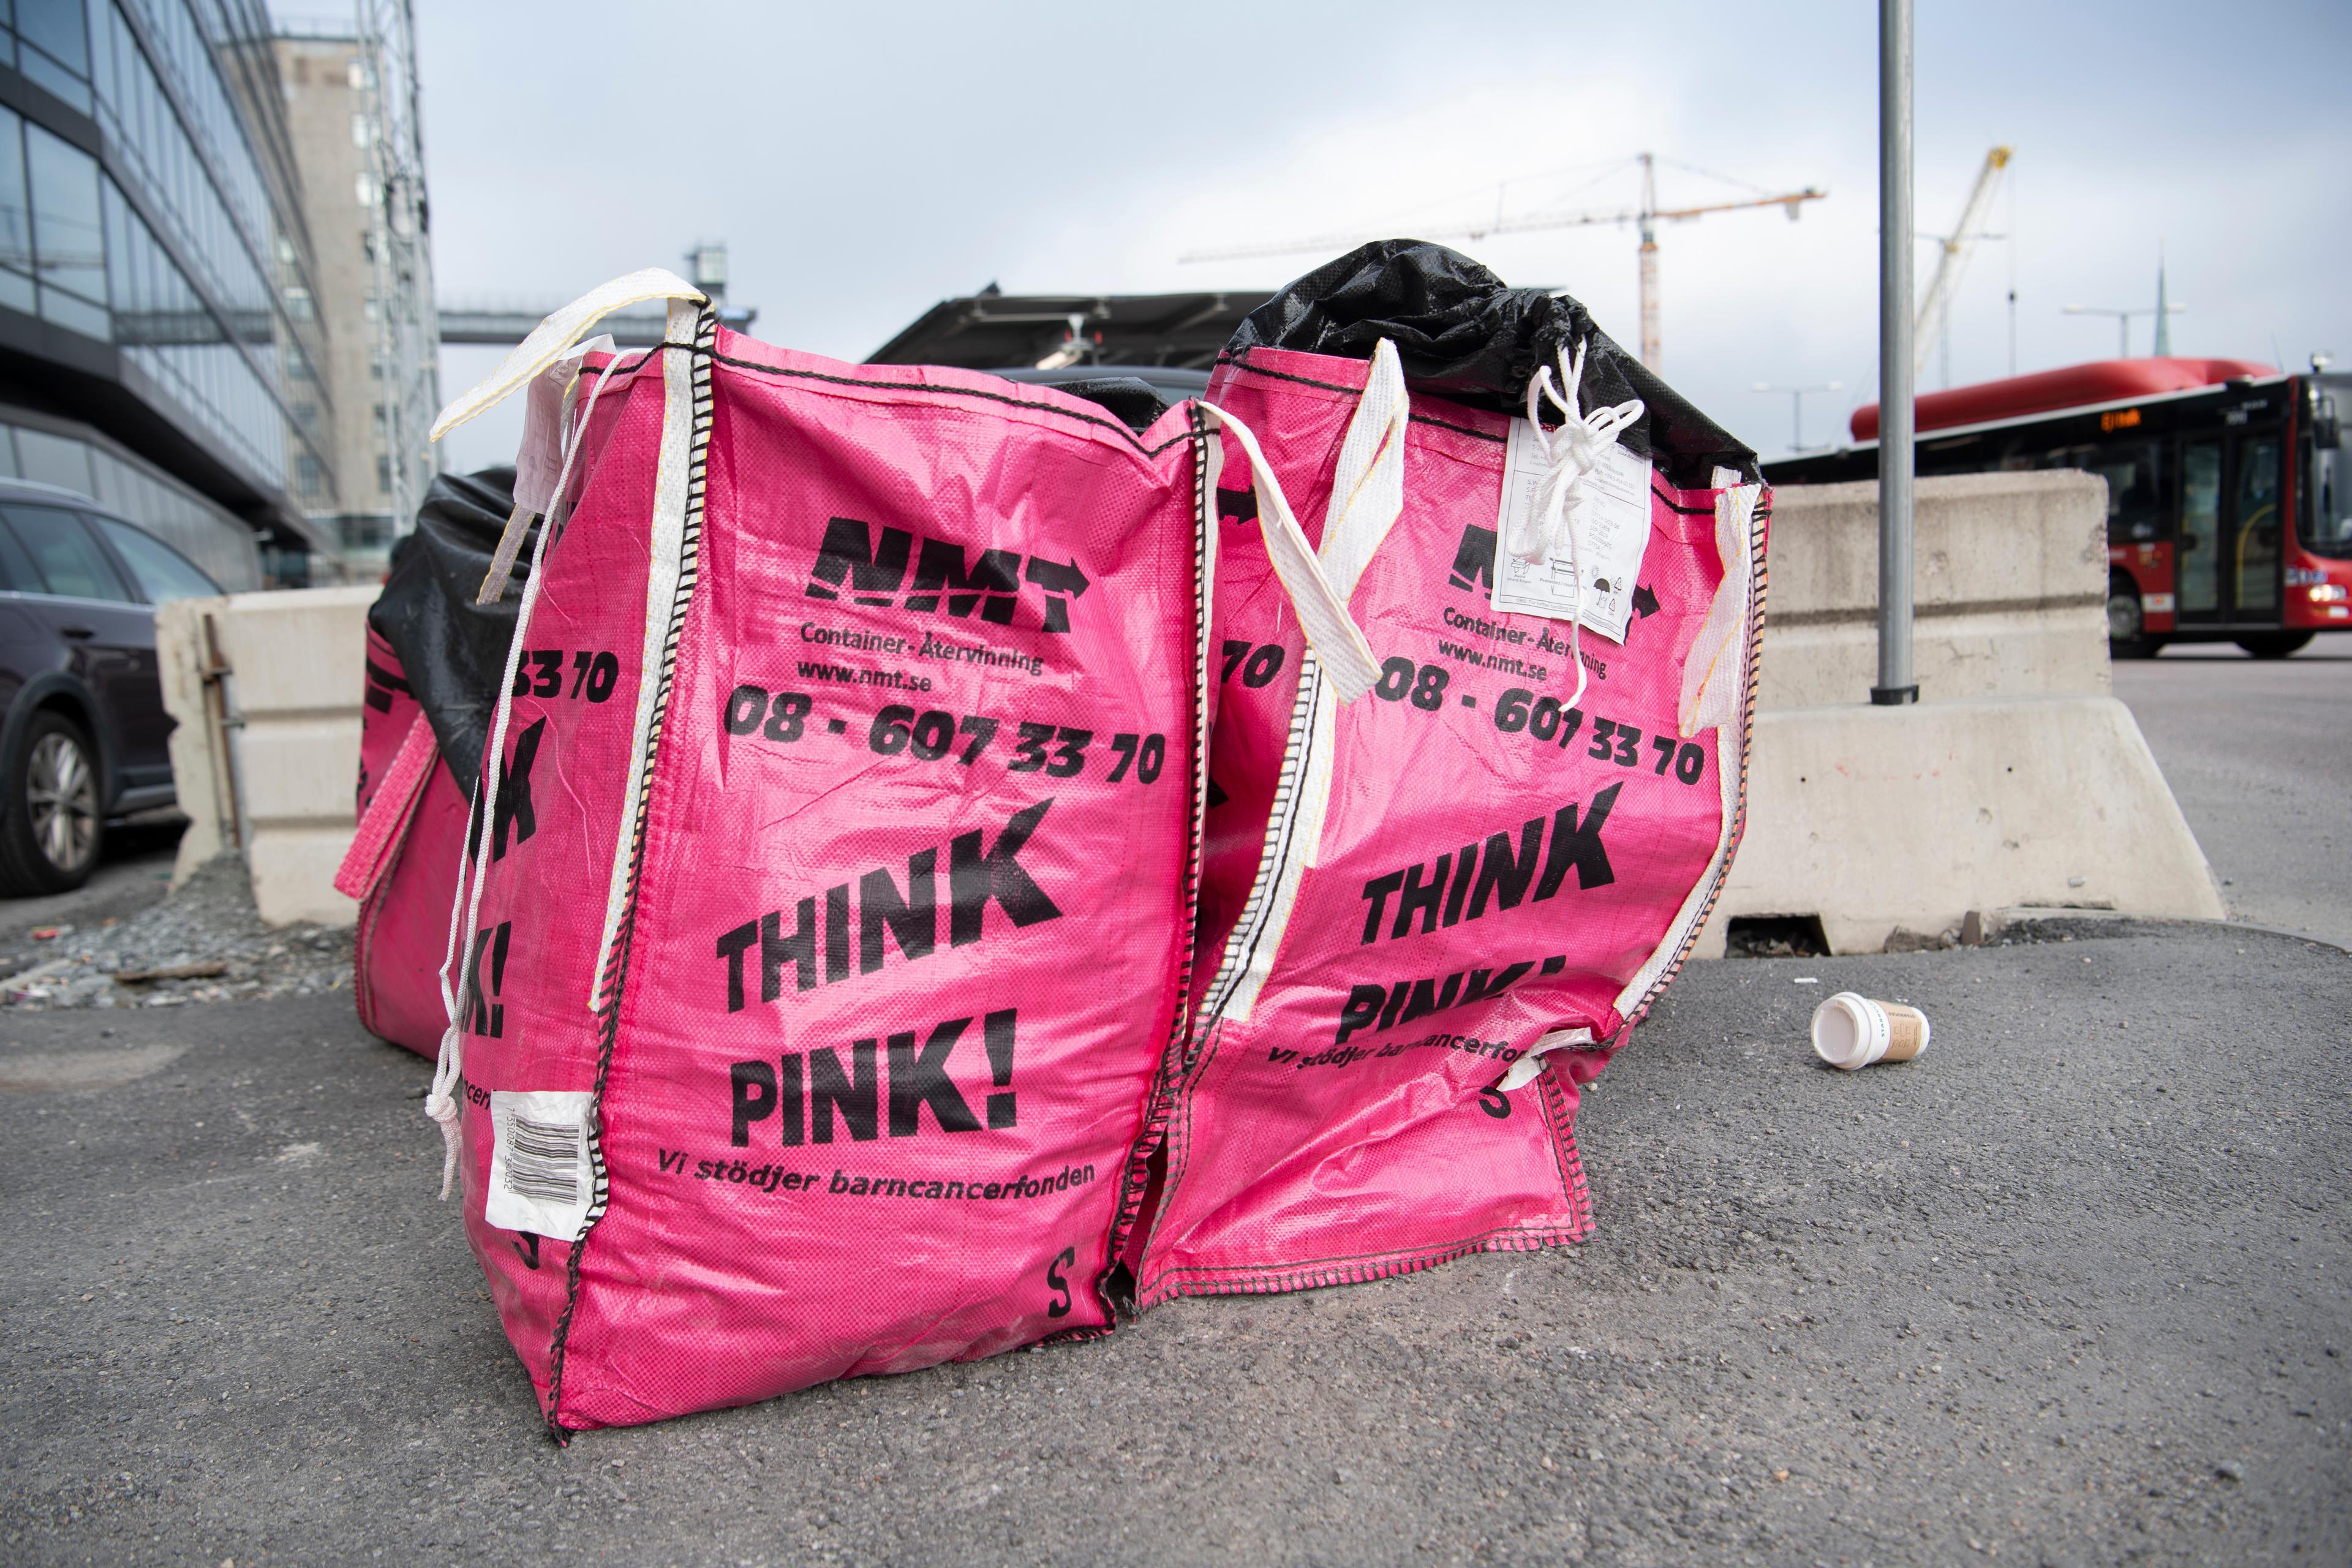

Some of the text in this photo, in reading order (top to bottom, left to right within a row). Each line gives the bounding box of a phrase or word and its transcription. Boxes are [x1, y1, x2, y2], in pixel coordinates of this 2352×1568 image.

[805, 517, 1090, 633] NMT
[511, 650, 619, 703] 33 70
[797, 661, 932, 692] www.nmt.se
[1221, 640, 1284, 688] 70
[1439, 639, 1547, 680] www.nmt.se
[724, 684, 812, 742] 08
[869, 704, 999, 766] 607
[1008, 722, 1094, 778] 33
[1106, 733, 1165, 785] 70
[1375, 655, 1449, 712] 08
[1588, 717, 1641, 767] 33
[1653, 735, 1705, 785] 70
[717, 796, 1063, 1014] THINK
[1361, 781, 1624, 946] THINK
[730, 1008, 1017, 1147] PINK!
[658, 1148, 1095, 1200] Vi stödjer barncancerfonden
[1047, 1246, 1075, 1319] S
